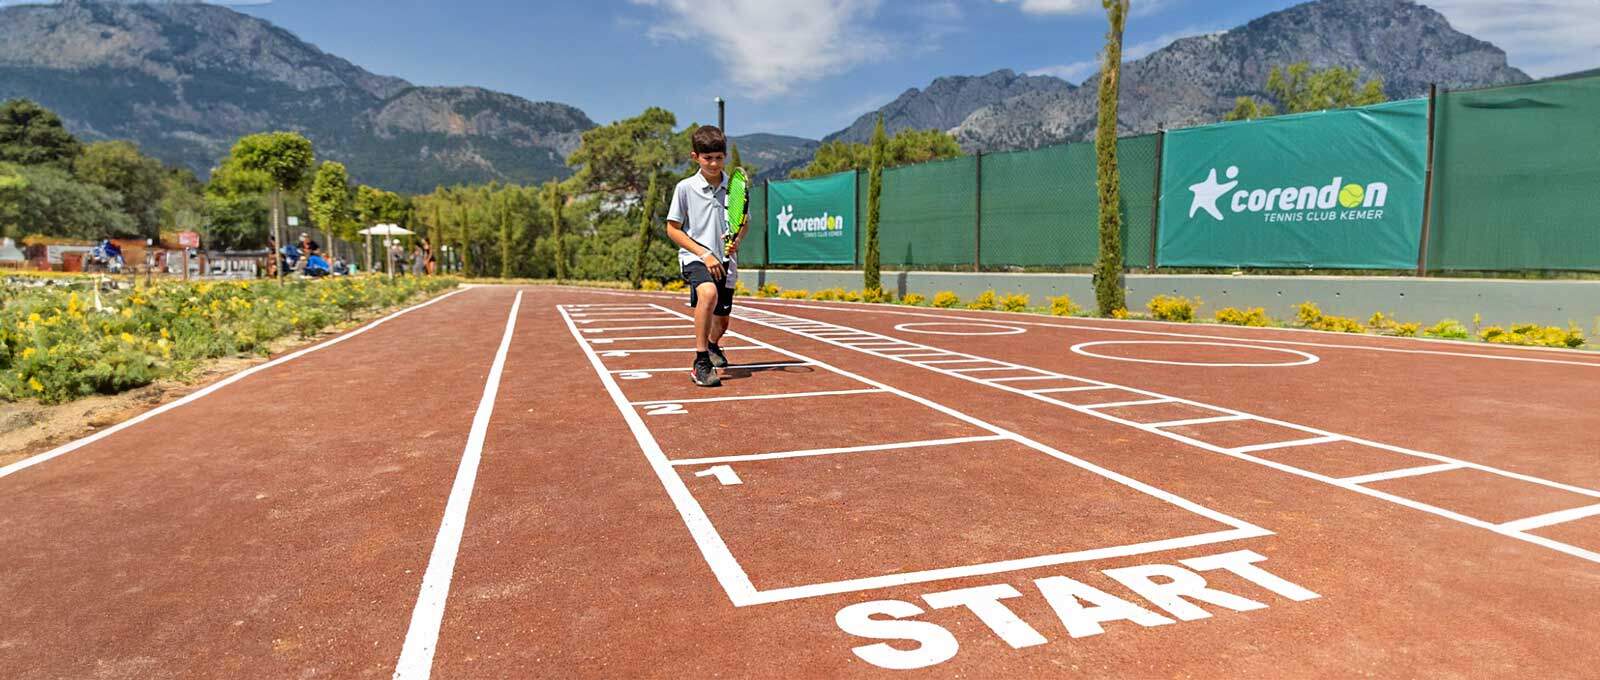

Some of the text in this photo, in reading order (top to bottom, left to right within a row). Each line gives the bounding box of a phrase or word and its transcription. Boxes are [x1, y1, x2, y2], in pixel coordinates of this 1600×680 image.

[1231, 176, 1388, 212] corendon
[791, 212, 843, 232] corendon
[1264, 209, 1384, 222] TENNIS CLUB KEMER
[643, 403, 689, 416] 2
[695, 464, 743, 486] 1
[835, 549, 1322, 670] START
